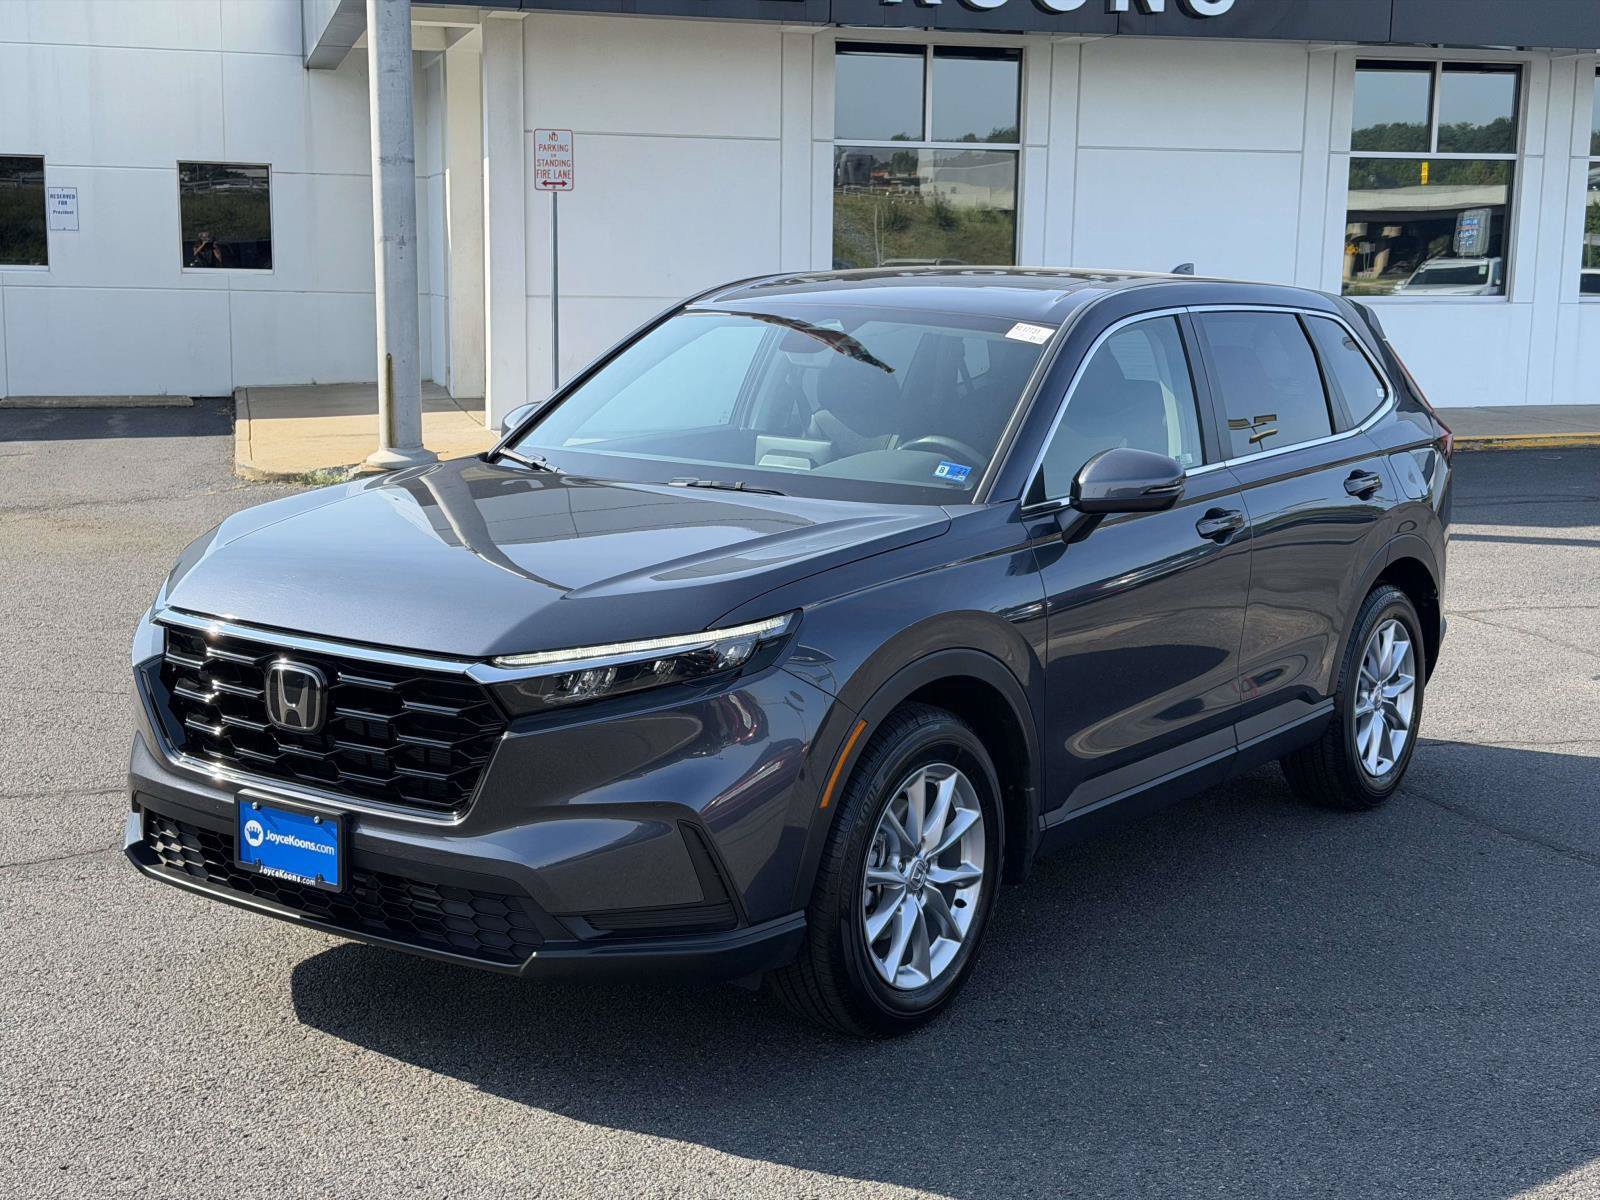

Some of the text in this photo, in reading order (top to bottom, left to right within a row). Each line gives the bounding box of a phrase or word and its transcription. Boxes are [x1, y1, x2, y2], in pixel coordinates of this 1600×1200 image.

[548, 132, 559, 142] NO
[538, 143, 569, 152] PARKING
[536, 159, 571, 168] STANDING
[536, 169, 571, 180] FIRE LANE
[265, 829, 335, 856] JoyceKoons.com
[259, 864, 316, 887] JoyceKoons.com
